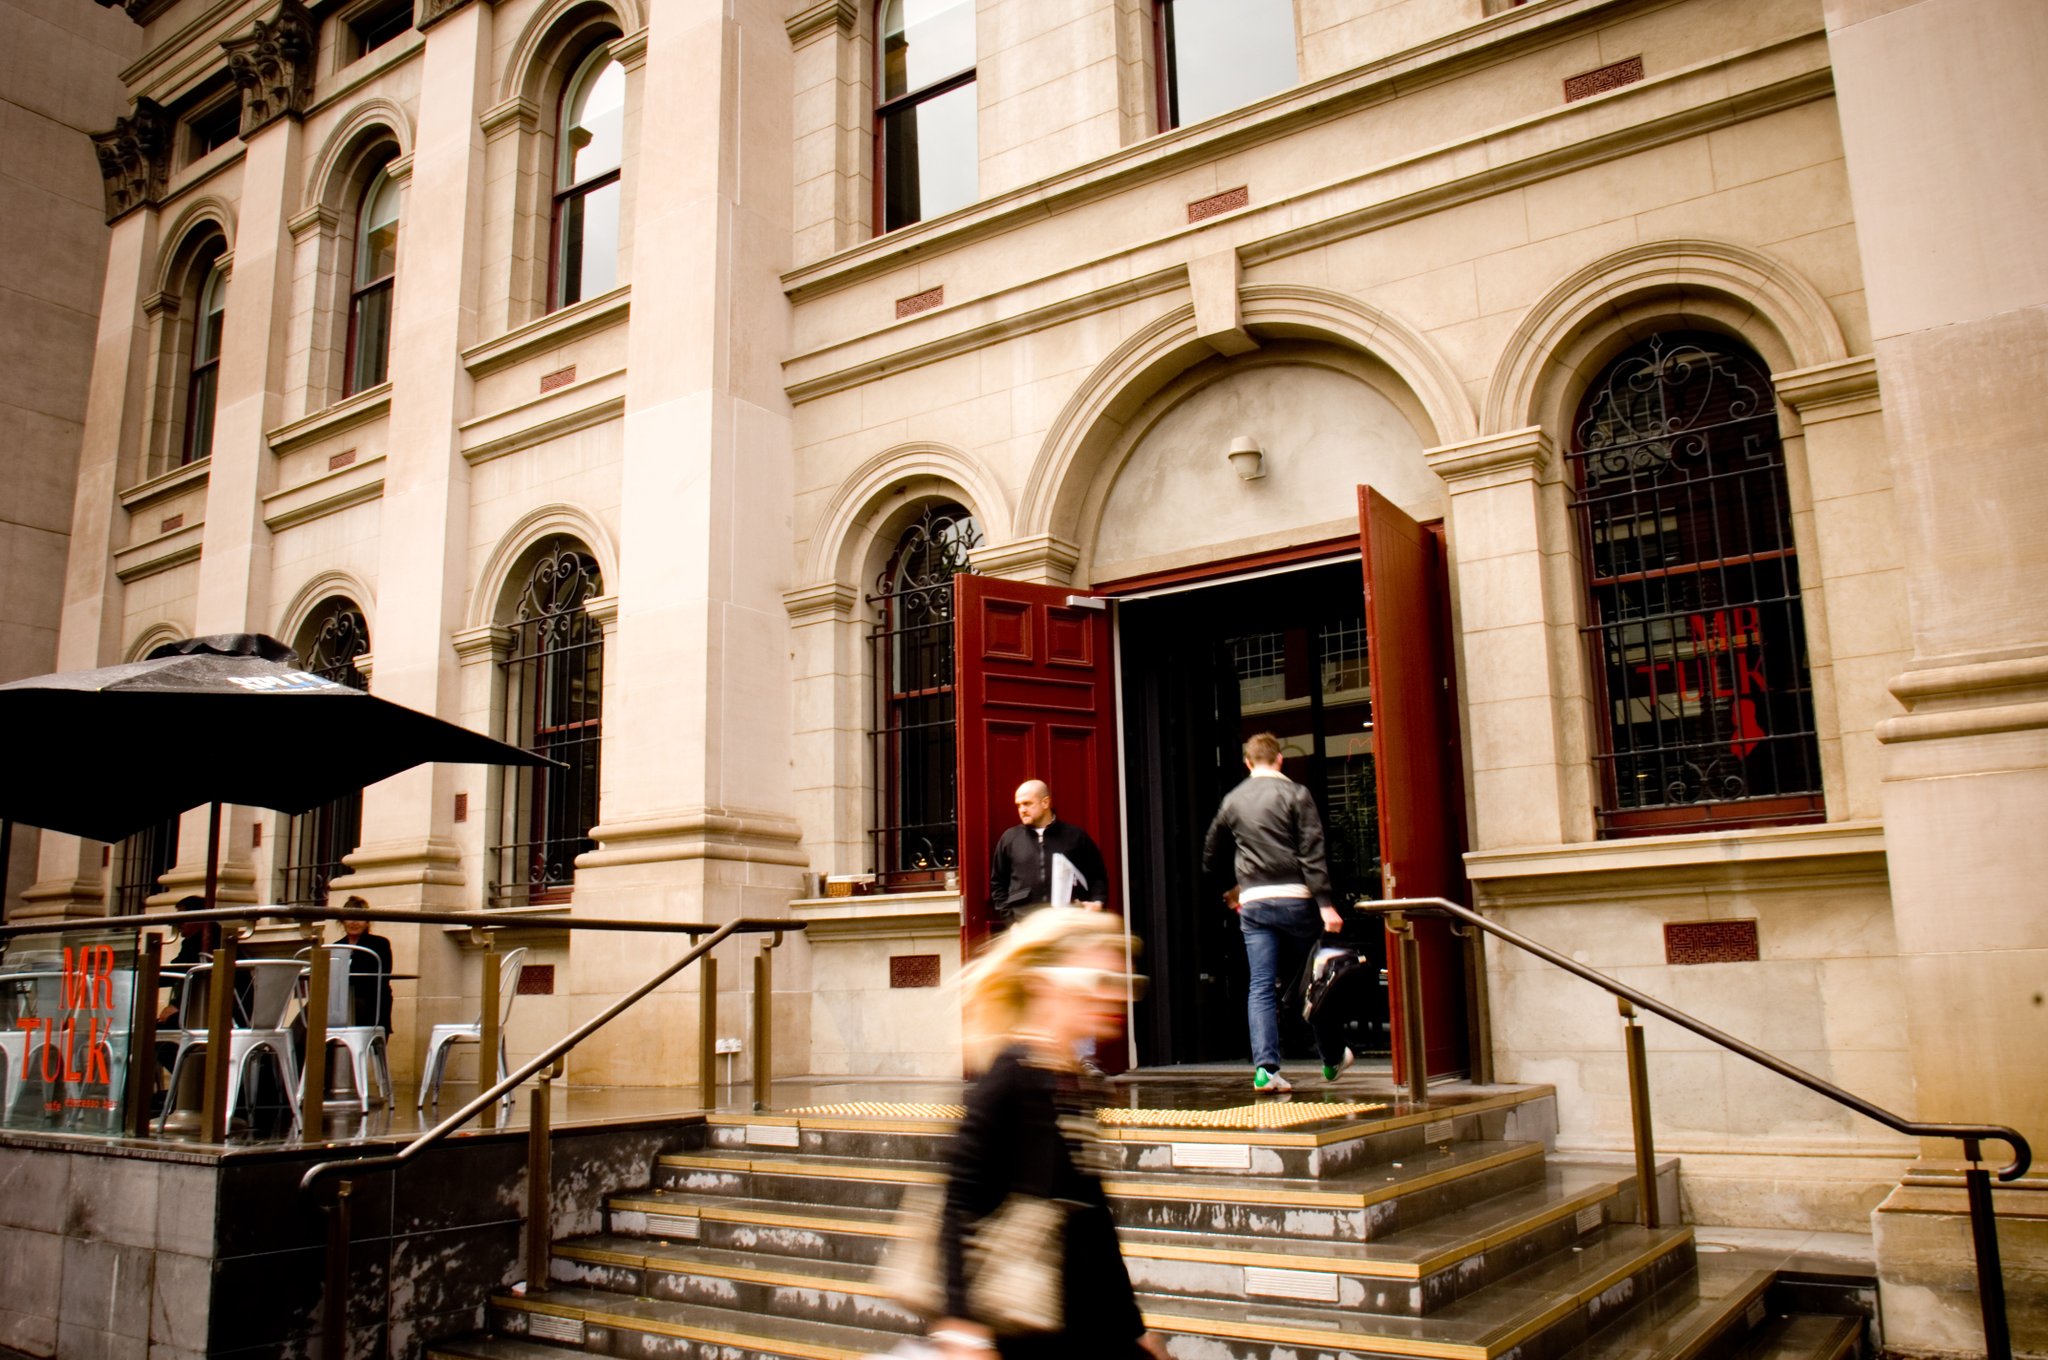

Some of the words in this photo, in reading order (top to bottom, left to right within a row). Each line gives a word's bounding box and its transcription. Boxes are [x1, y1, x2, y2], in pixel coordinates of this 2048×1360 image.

[1690, 607, 1763, 656] MR
[1636, 652, 1769, 706] TULK
[58, 944, 115, 1010] MR
[16, 1017, 113, 1084] TULK
